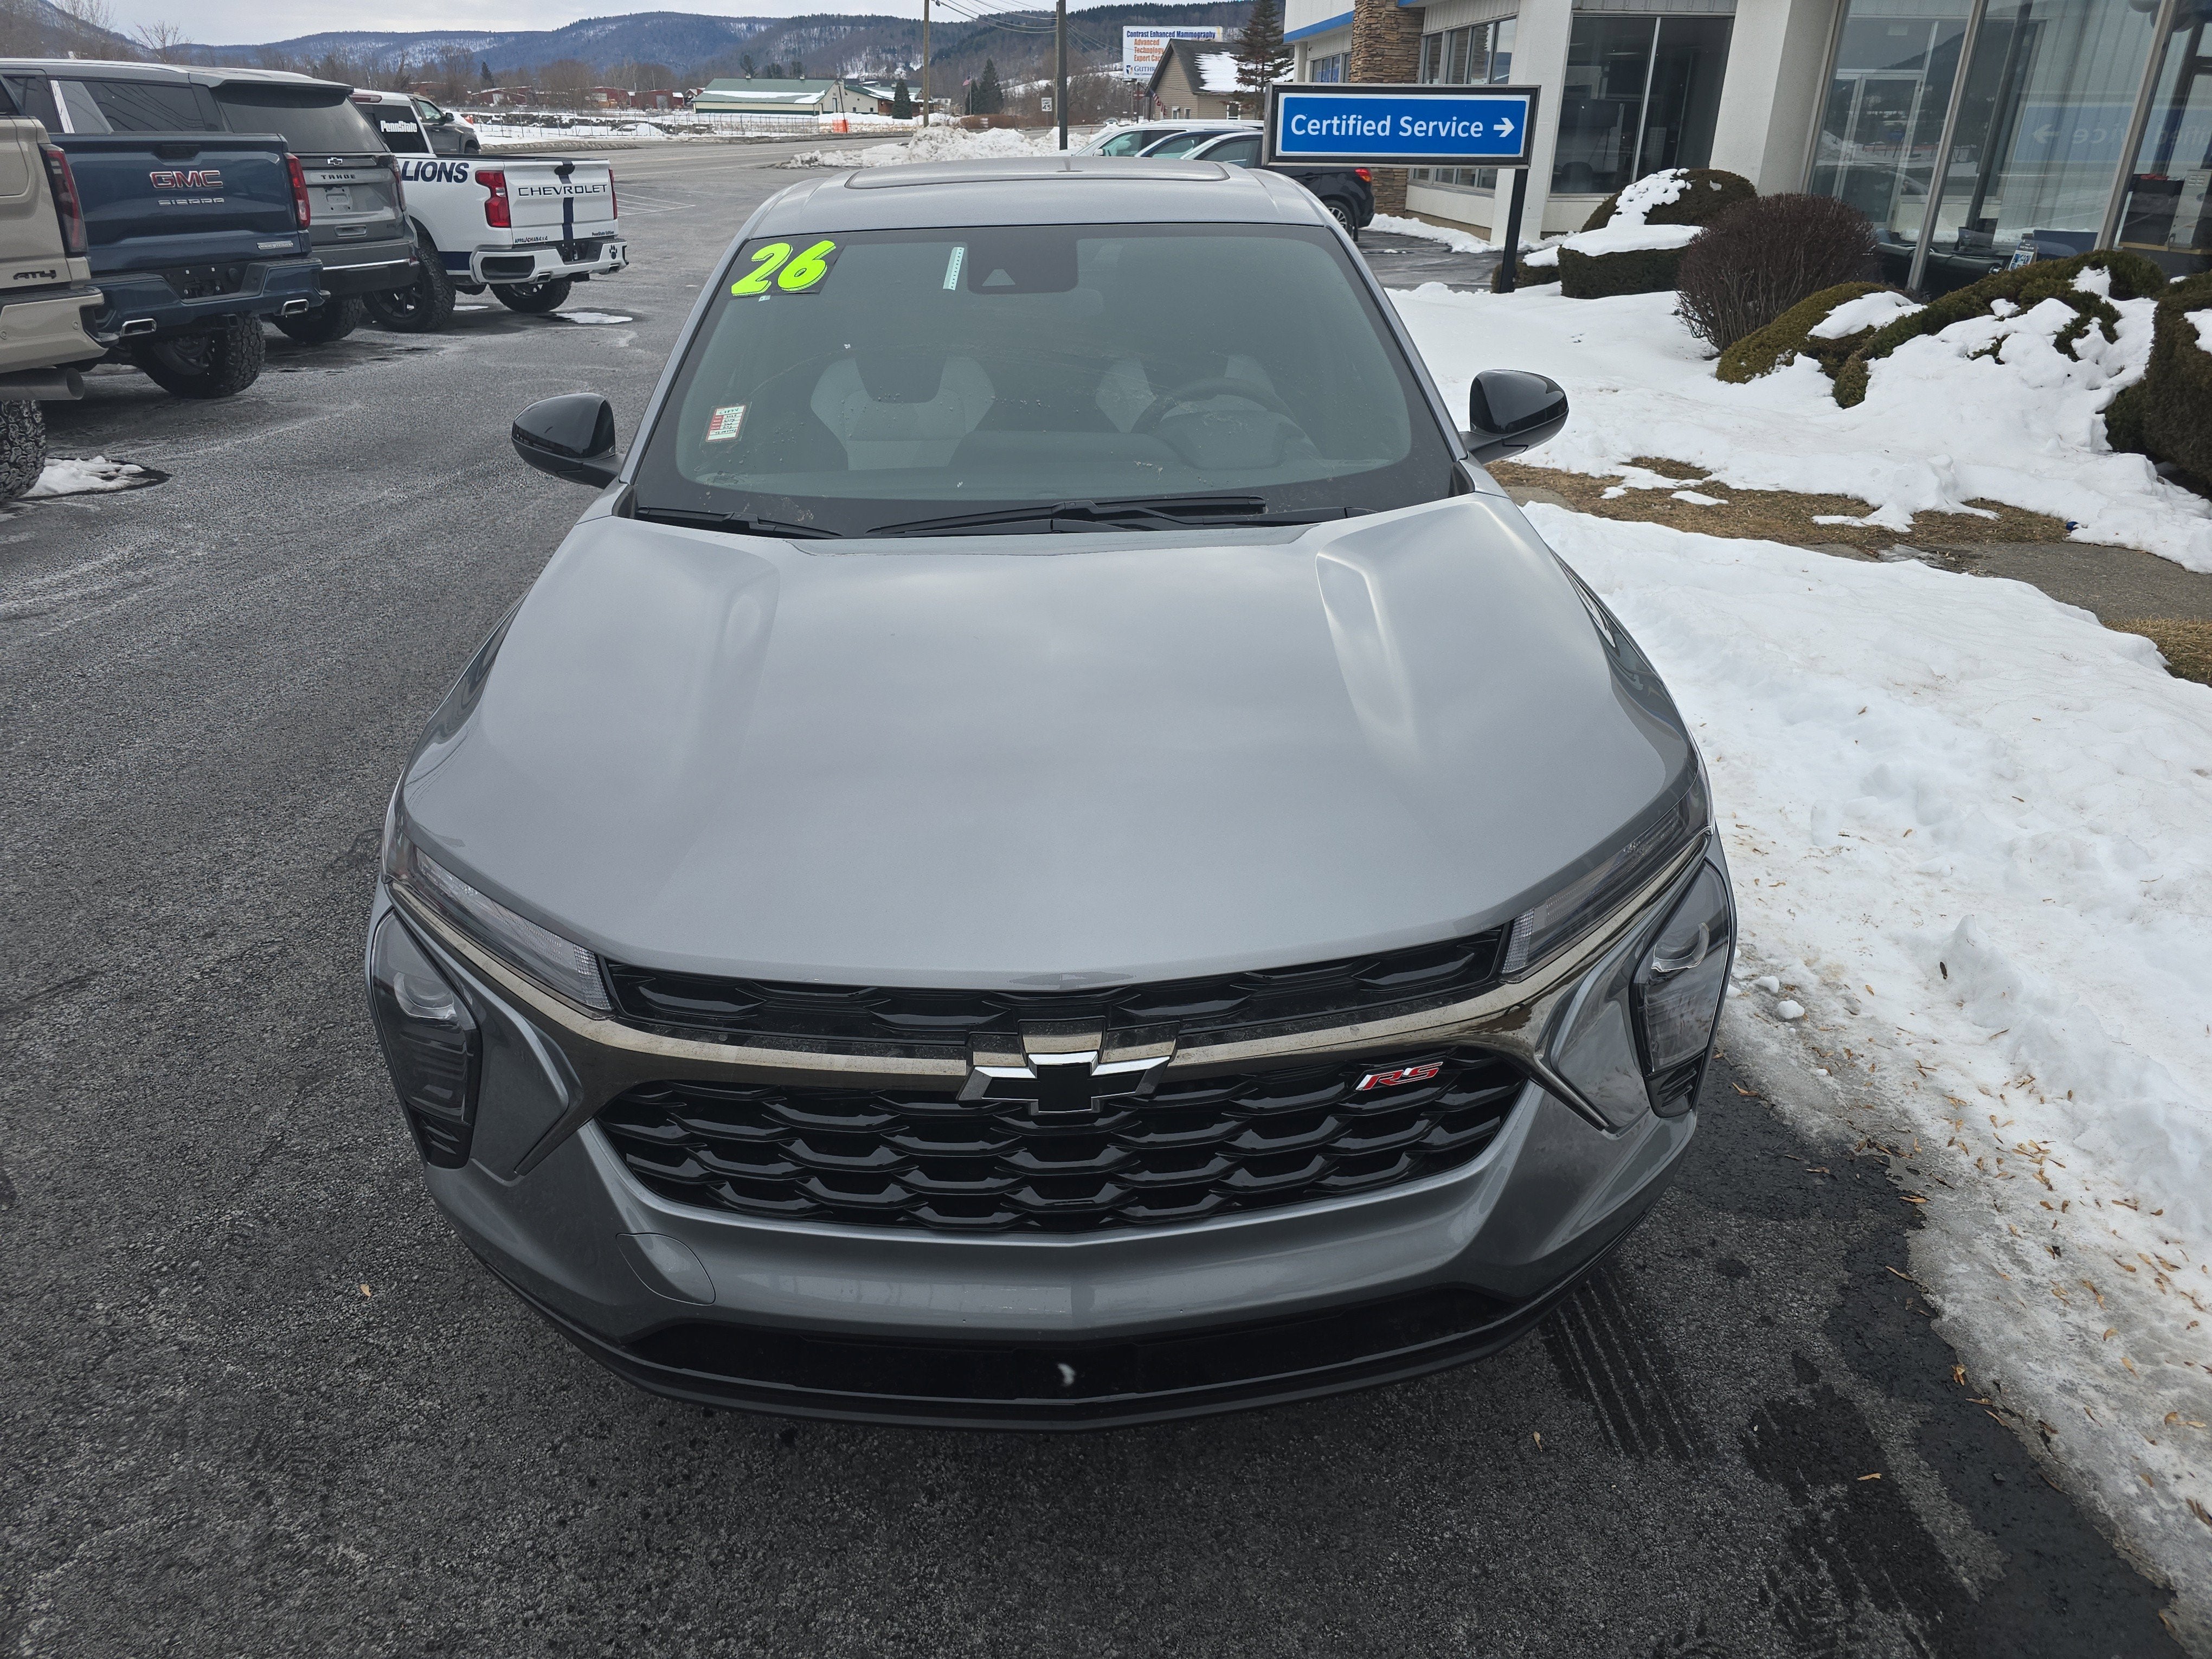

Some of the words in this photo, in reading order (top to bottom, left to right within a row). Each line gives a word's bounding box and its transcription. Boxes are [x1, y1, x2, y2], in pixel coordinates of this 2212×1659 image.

[1176, 31, 1216, 39] Mammography
[1290, 114, 1391, 136] Certified
[1399, 115, 1484, 137] Service
[150, 170, 223, 188] GMC
[401, 161, 470, 183] LIONS
[518, 184, 607, 196] CHEVROLET
[158, 197, 224, 206] SIERRA
[13, 270, 57, 280] AT4
[731, 240, 836, 296] 26
[1355, 1062, 1443, 1091] RS
